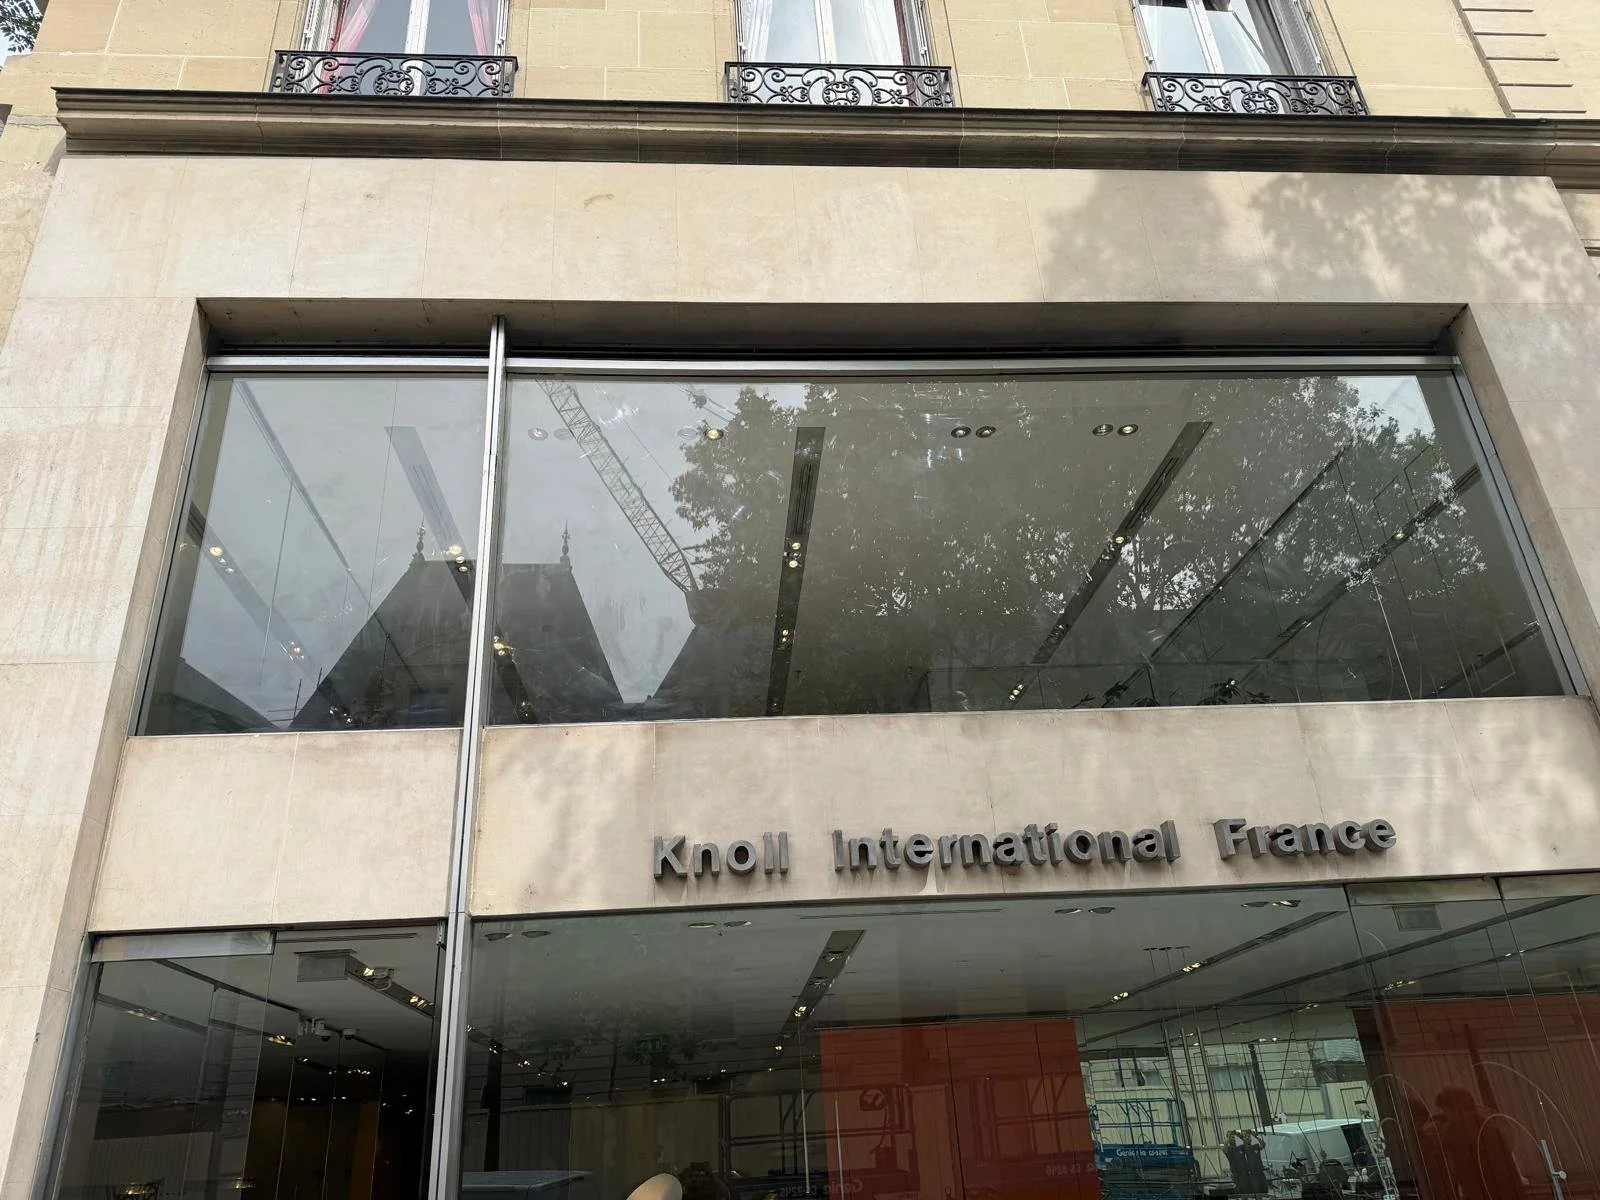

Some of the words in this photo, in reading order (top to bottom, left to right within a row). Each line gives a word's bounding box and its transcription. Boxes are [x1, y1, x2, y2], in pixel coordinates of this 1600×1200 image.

[653, 831, 789, 879] Knoll
[831, 819, 1182, 872] International
[1213, 817, 1398, 861] France
